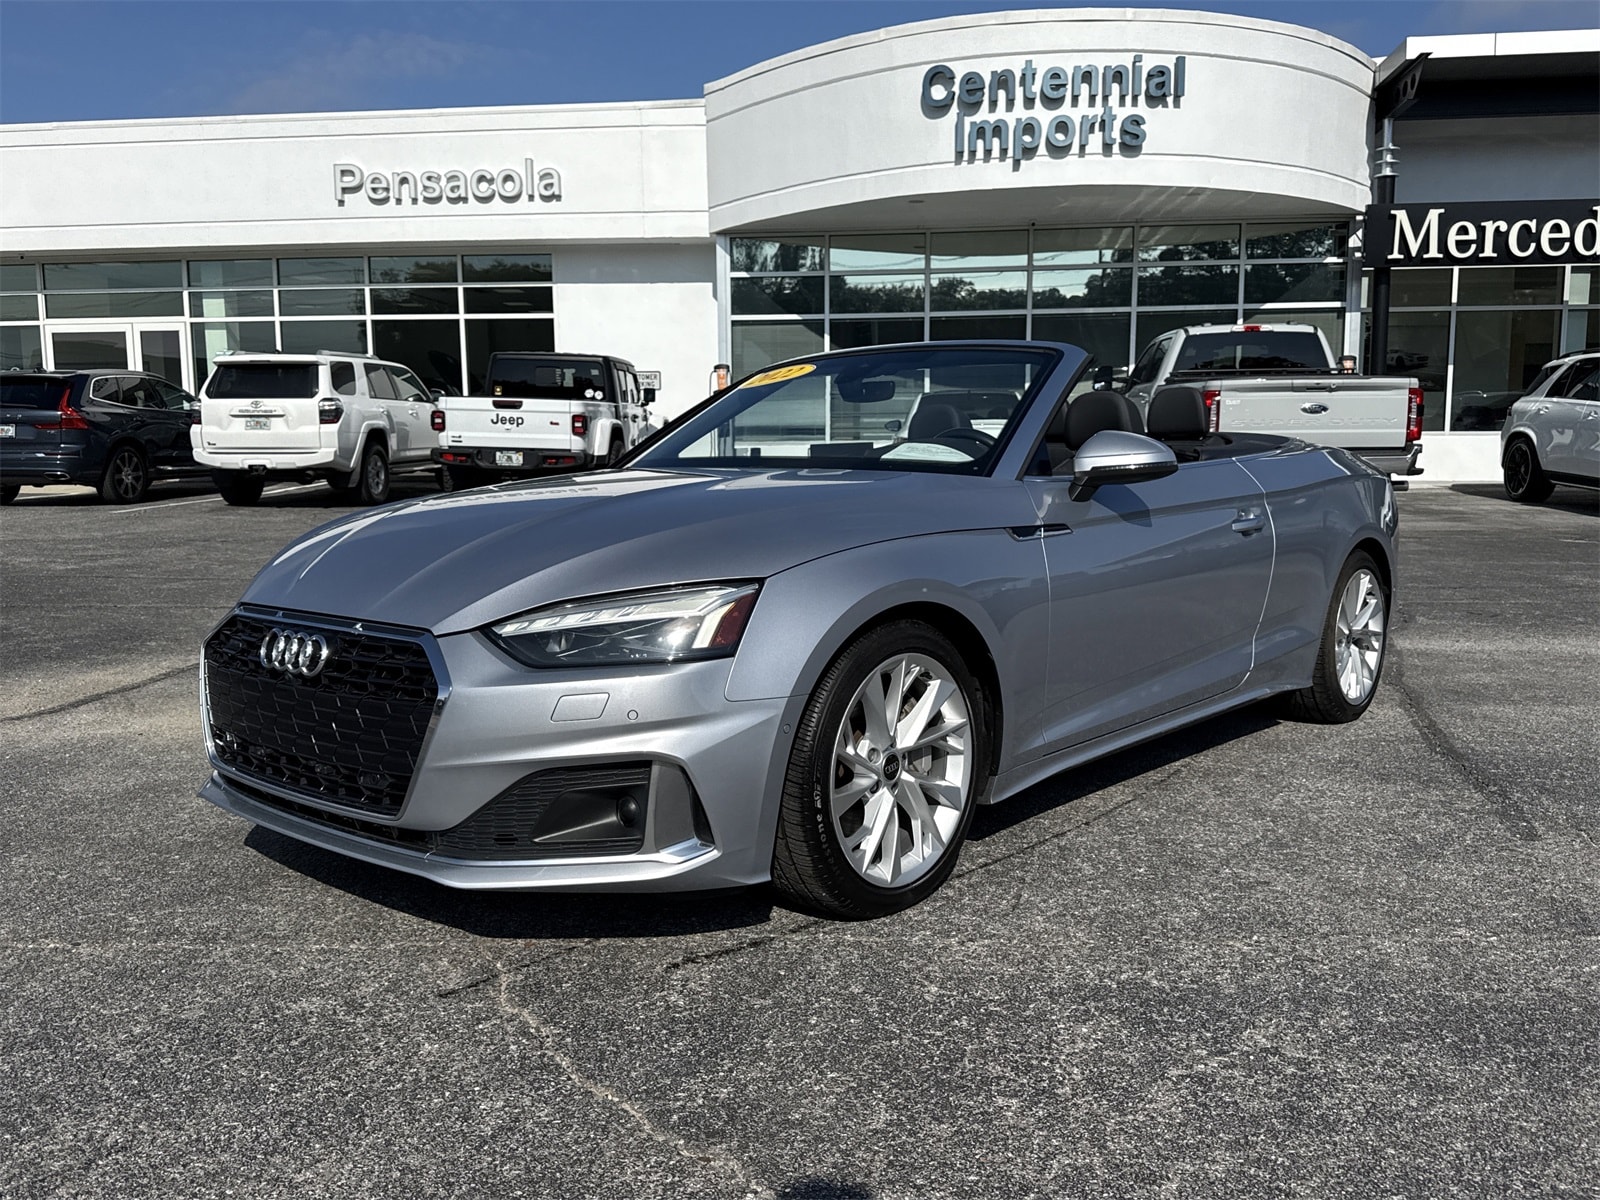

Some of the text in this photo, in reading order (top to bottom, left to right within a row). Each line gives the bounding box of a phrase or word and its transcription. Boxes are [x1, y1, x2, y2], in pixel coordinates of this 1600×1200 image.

[921, 54, 1186, 112] Centennial
[955, 105, 1147, 165] Imports
[333, 158, 562, 206] Pensacola
[490, 413, 525, 428] Jeep
